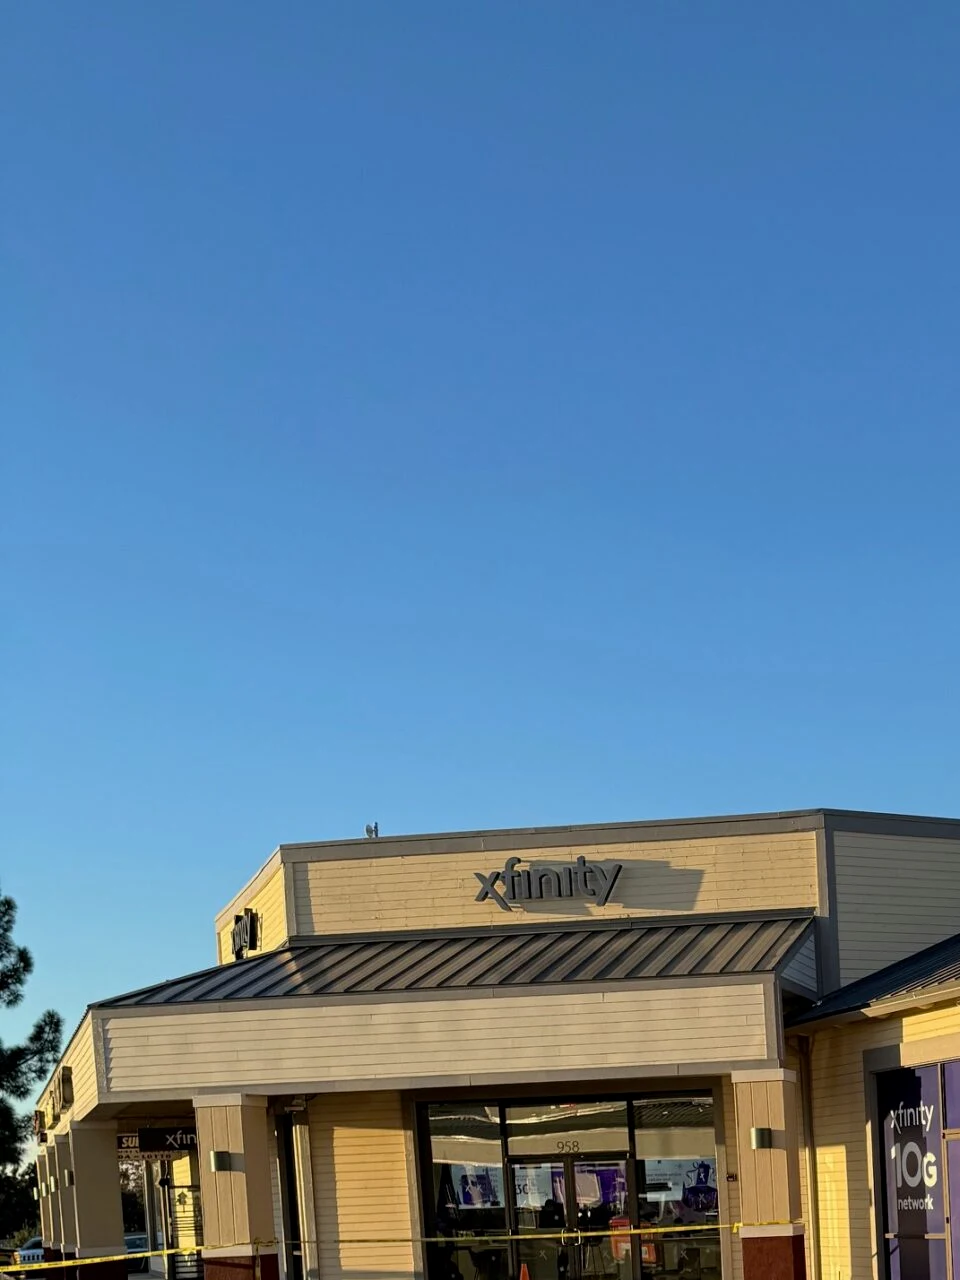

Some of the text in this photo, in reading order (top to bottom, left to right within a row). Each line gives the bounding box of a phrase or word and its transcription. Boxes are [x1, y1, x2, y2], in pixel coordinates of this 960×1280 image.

[474, 855, 623, 912] xfinity
[890, 1100, 934, 1134] xfinity
[556, 1140, 580, 1154] 958
[890, 1142, 938, 1188] 10G
[898, 1194, 934, 1210] network
